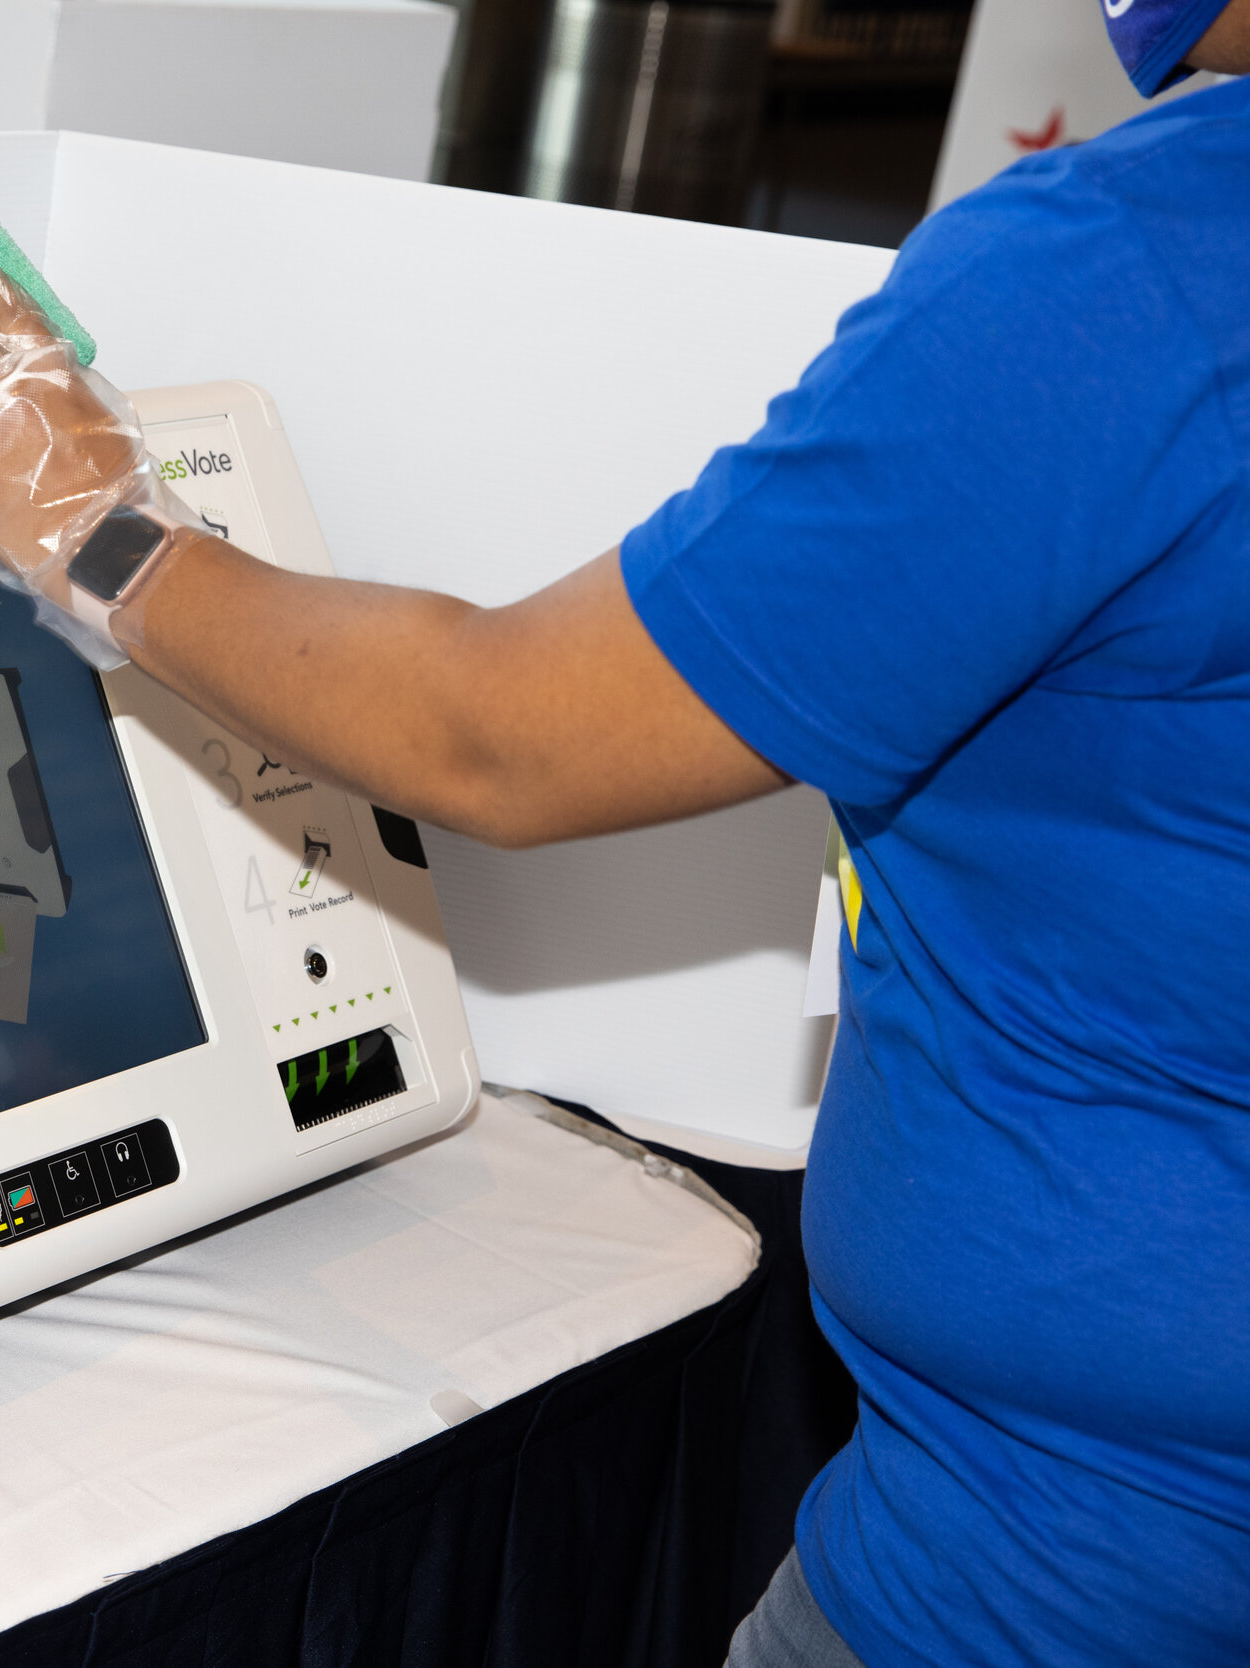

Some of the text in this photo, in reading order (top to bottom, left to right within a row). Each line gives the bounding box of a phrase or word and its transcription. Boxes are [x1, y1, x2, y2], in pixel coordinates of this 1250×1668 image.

[202, 738, 243, 811] 3
[252, 781, 314, 803] Verify Selections
[244, 854, 277, 926] 4
[288, 891, 354, 919] Print Vote Record
